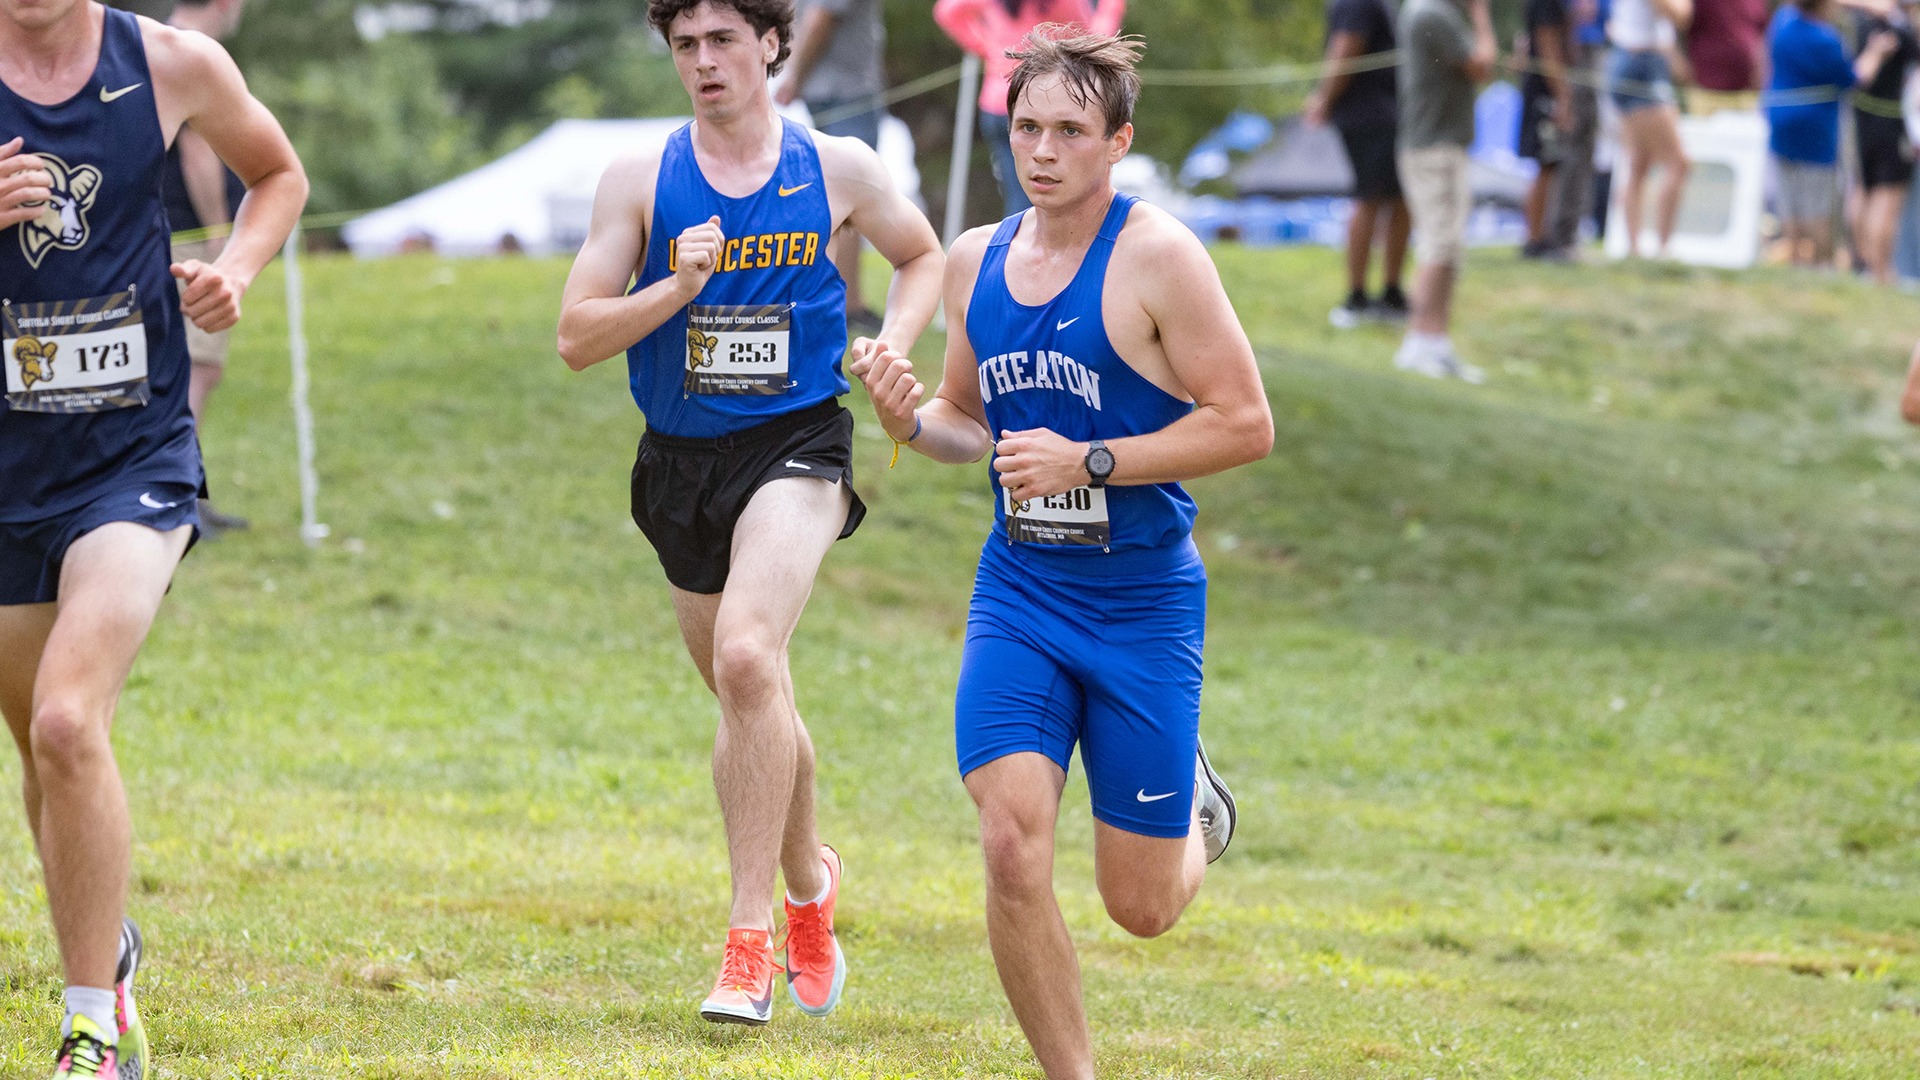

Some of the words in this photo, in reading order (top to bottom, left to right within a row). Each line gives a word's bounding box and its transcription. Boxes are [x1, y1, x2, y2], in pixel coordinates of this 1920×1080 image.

[669, 232, 819, 273] CESTER
[715, 316, 733, 324] SHORT
[735, 316, 755, 324] COURSE
[757, 316, 779, 324] CLASSIC
[74, 342, 129, 373] 173
[729, 343, 776, 363] 253
